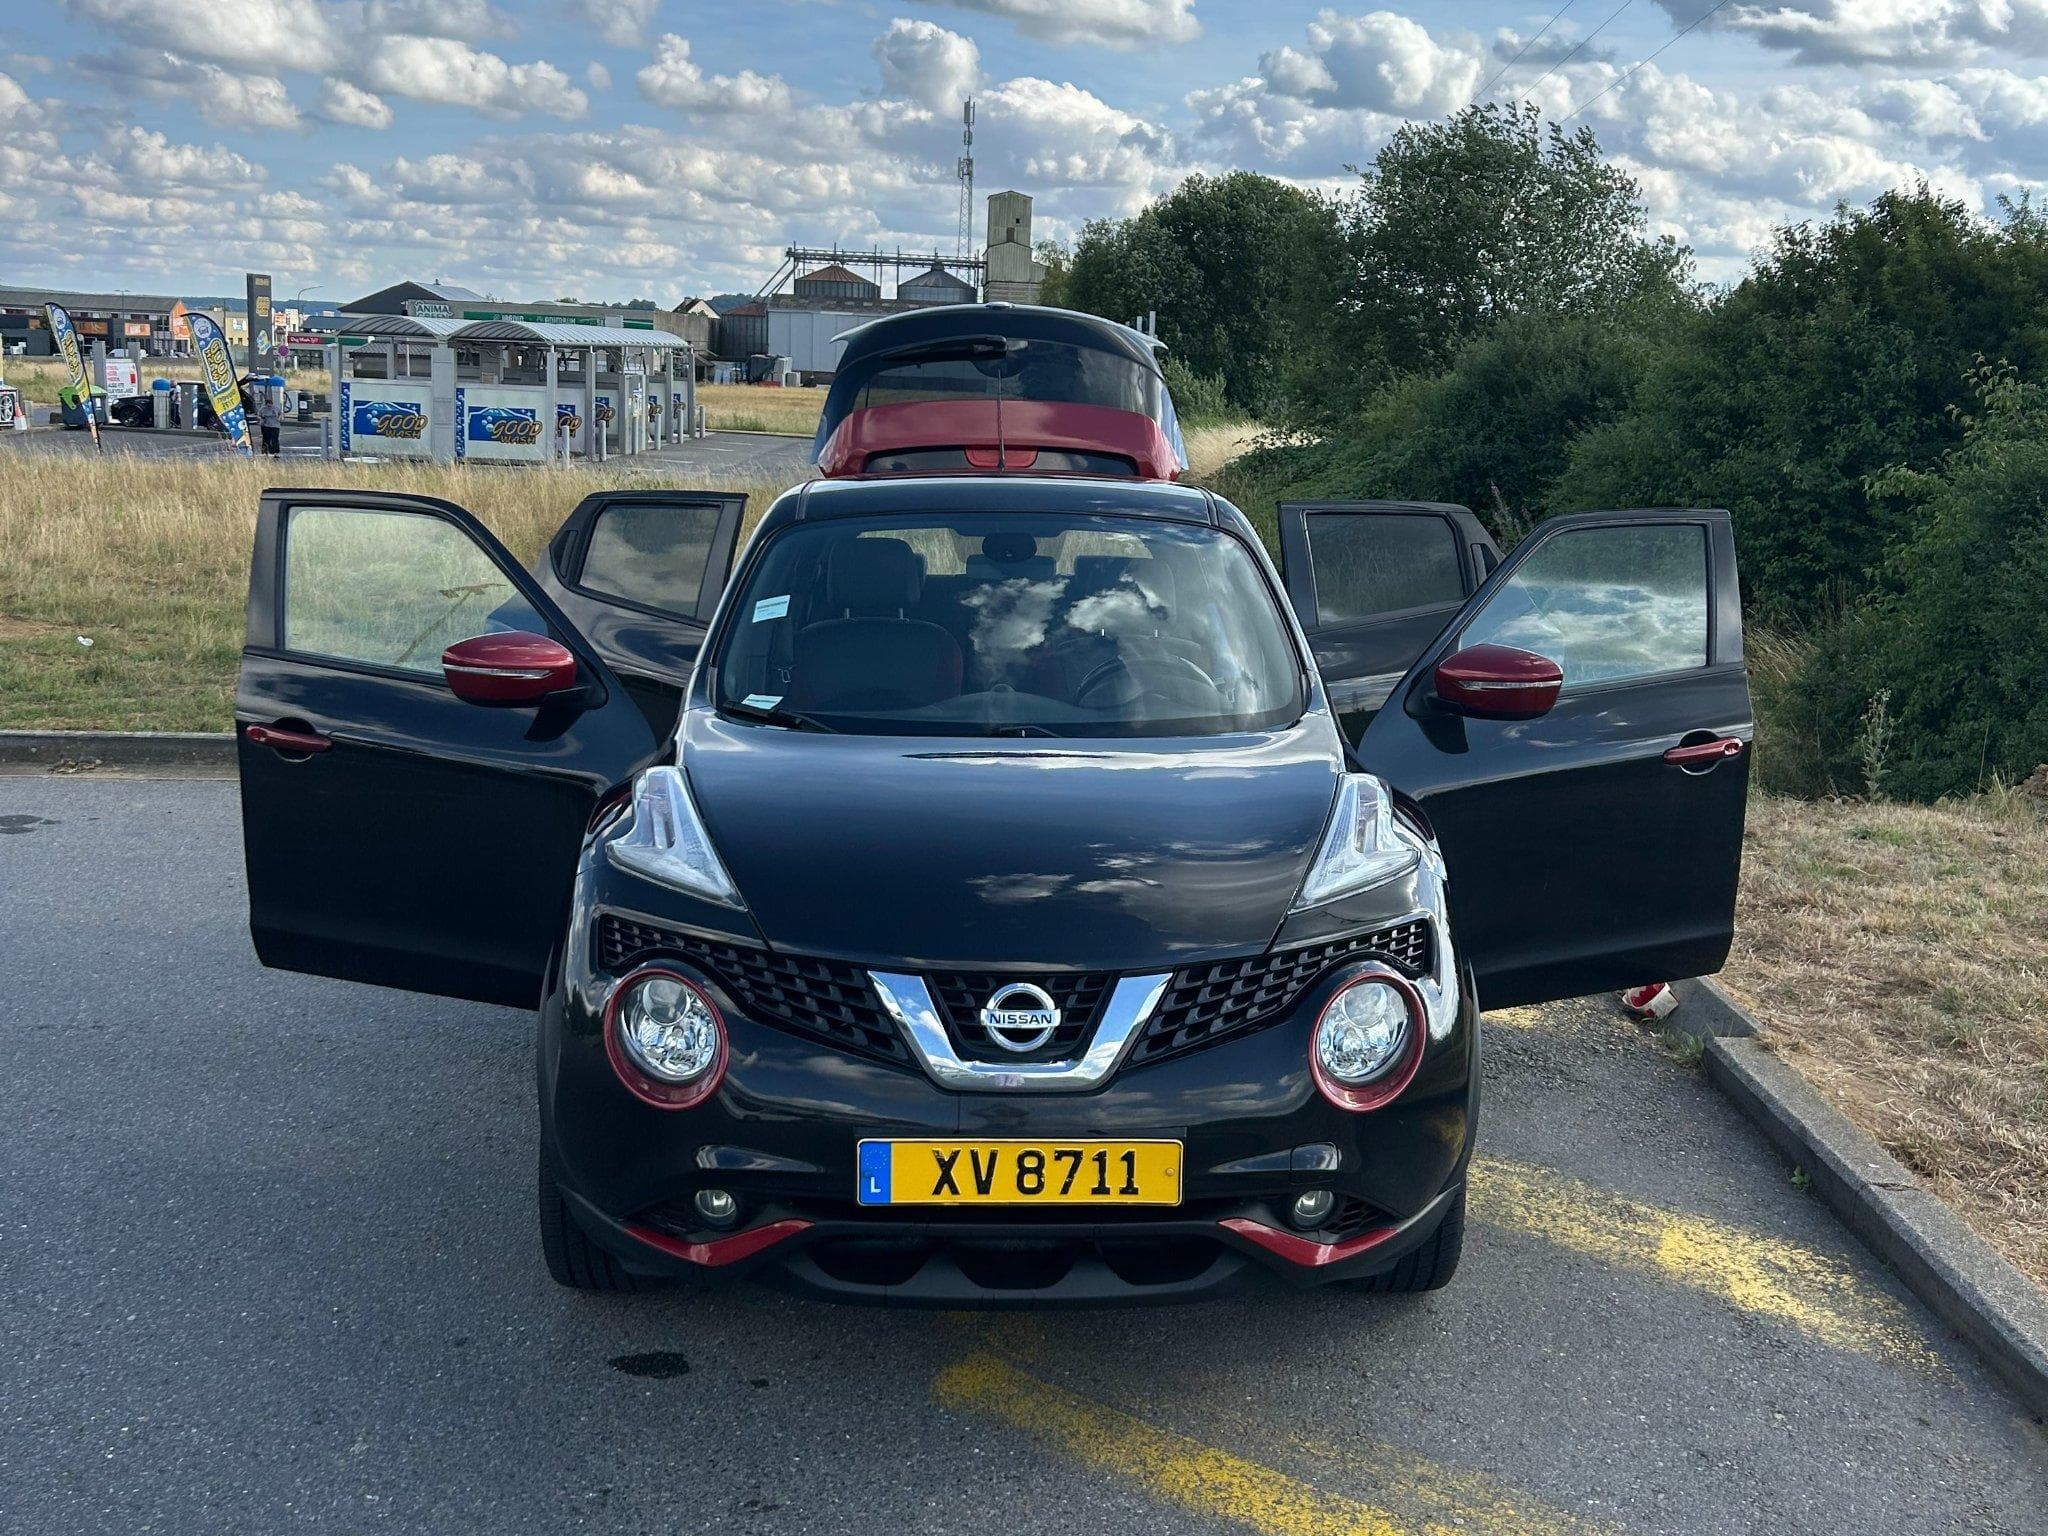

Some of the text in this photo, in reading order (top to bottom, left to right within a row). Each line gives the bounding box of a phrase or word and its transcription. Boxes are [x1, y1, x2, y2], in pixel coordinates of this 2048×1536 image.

[417, 304, 449, 313] ANIMA
[377, 414, 428, 433] GOOD
[385, 429, 421, 439] WASH
[491, 420, 543, 439] GOOD
[500, 435, 536, 445] WASH
[989, 1013, 1052, 1024] NISSAN
[870, 1148, 1139, 1195] L XV 8711
